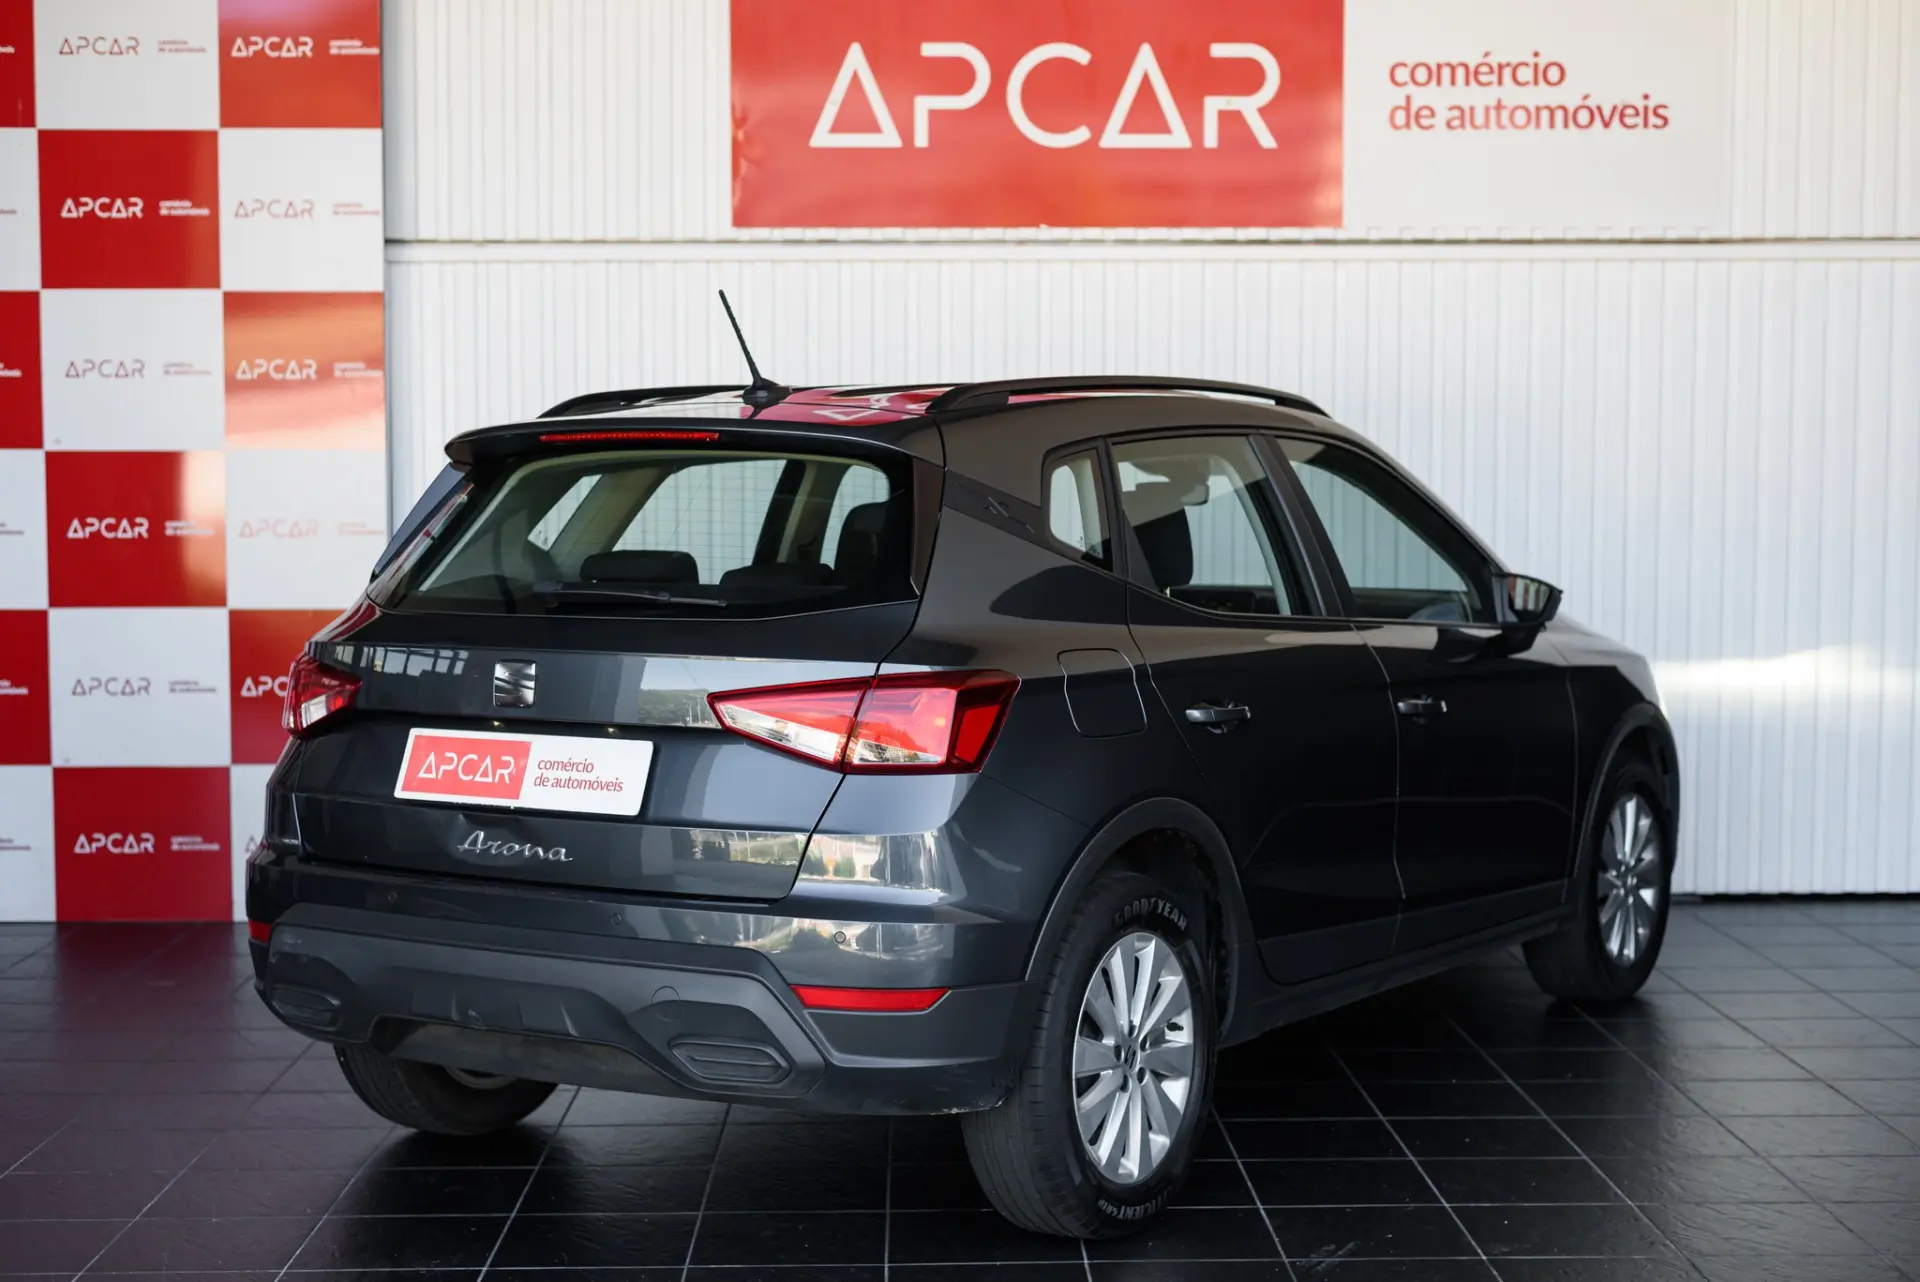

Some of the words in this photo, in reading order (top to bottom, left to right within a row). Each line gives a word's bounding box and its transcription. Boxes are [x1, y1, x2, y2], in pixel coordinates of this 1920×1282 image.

[59, 36, 140, 56] APCAR
[230, 36, 313, 58] APCAR
[1389, 51, 1566, 87] comércio
[809, 42, 1281, 148] APCAR
[1389, 94, 1436, 131] de
[1445, 93, 1670, 131] automóveis
[60, 196, 144, 219] APCAR
[234, 198, 314, 219] APCAR
[64, 358, 146, 380] APCAR
[235, 358, 317, 381] APCAR
[66, 516, 150, 539] APCAR
[71, 677, 152, 697] APCAR
[240, 675, 289, 698] APC
[418, 751, 516, 784] APCAR
[537, 757, 595, 774] comércio
[533, 772, 551, 788] de
[551, 776, 624, 793] automóveis
[73, 832, 155, 854] APCAR
[457, 830, 573, 863] Arona
[1114, 897, 1189, 931] GOODYEAR
